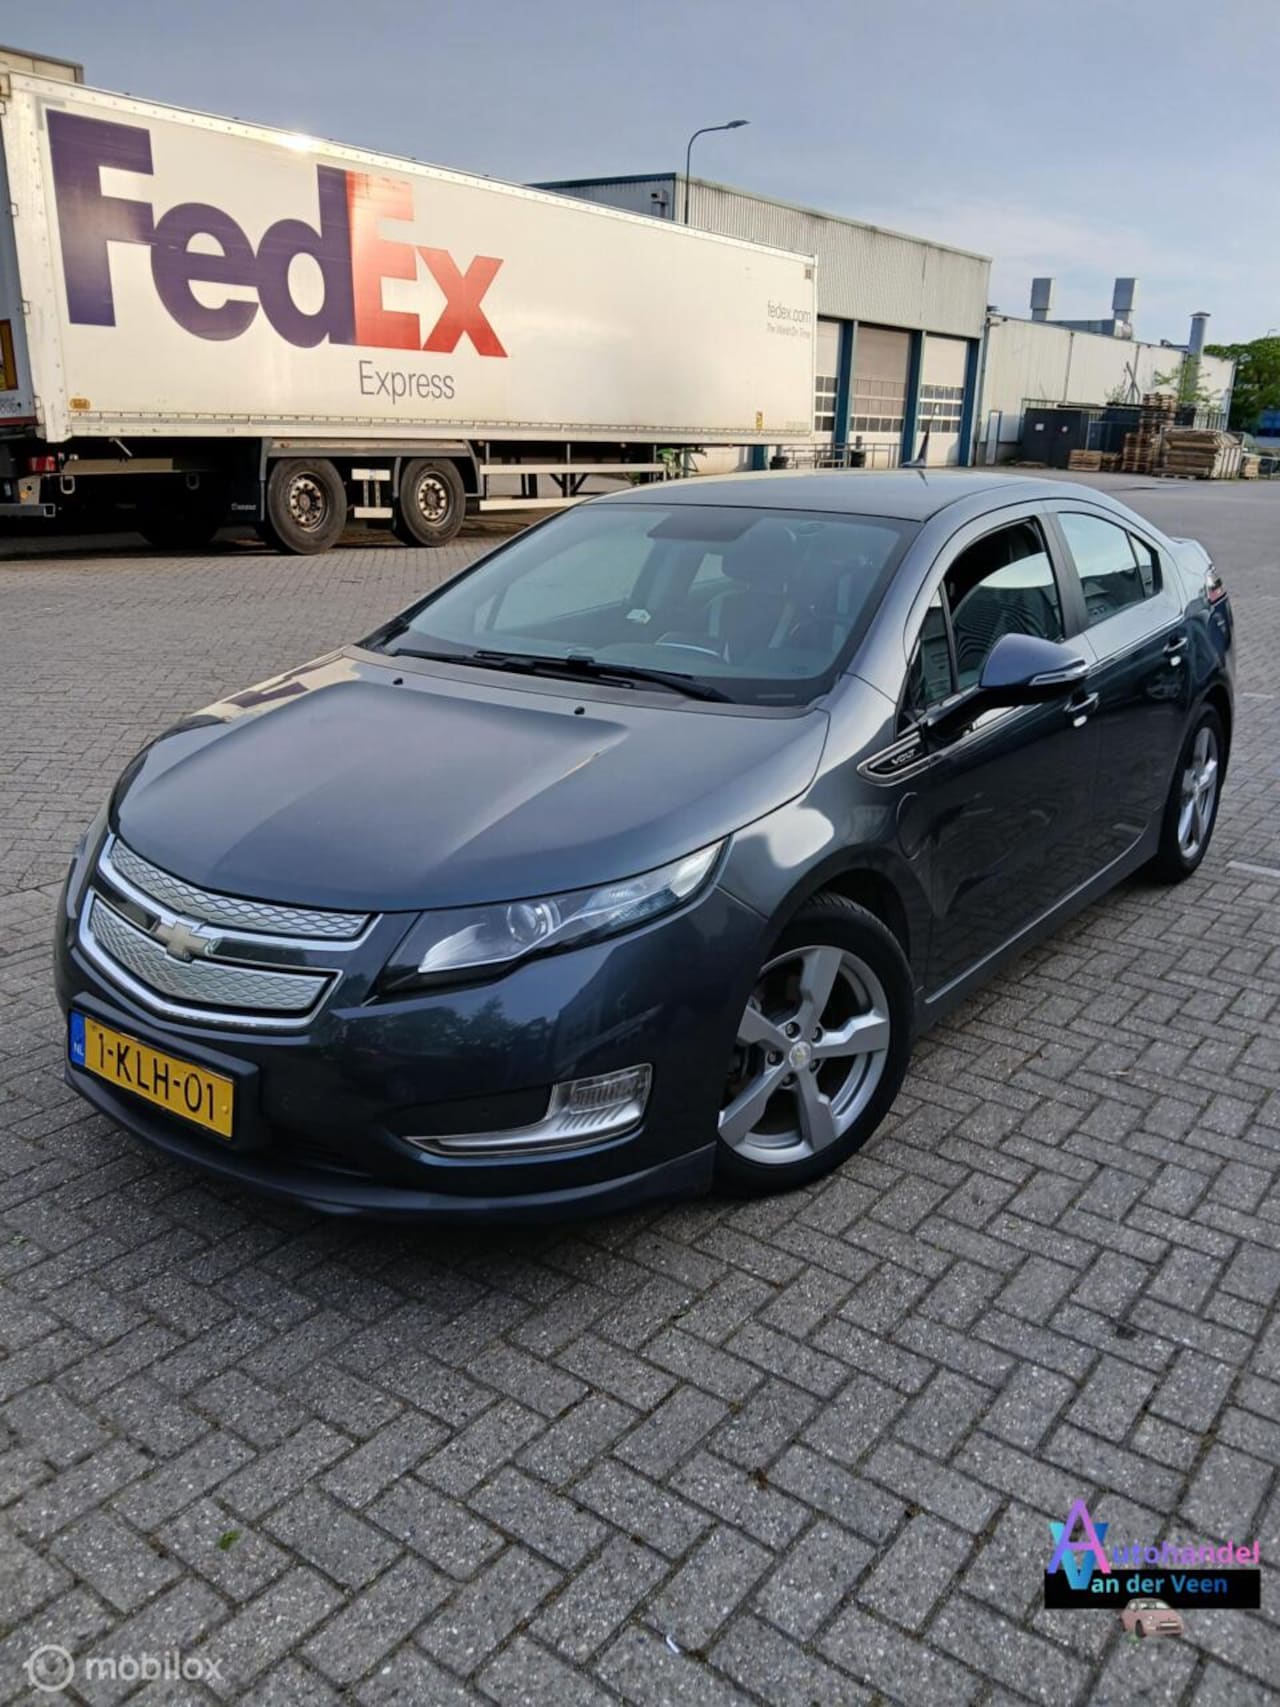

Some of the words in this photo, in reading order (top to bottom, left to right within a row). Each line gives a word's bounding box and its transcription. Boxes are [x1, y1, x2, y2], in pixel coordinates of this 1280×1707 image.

[46, 109, 508, 358] FedEx
[767, 299, 811, 323] fedex.com
[359, 360, 455, 405] Express
[73, 1041, 85, 1057] NL
[98, 1033, 214, 1121] 1-KLH-01
